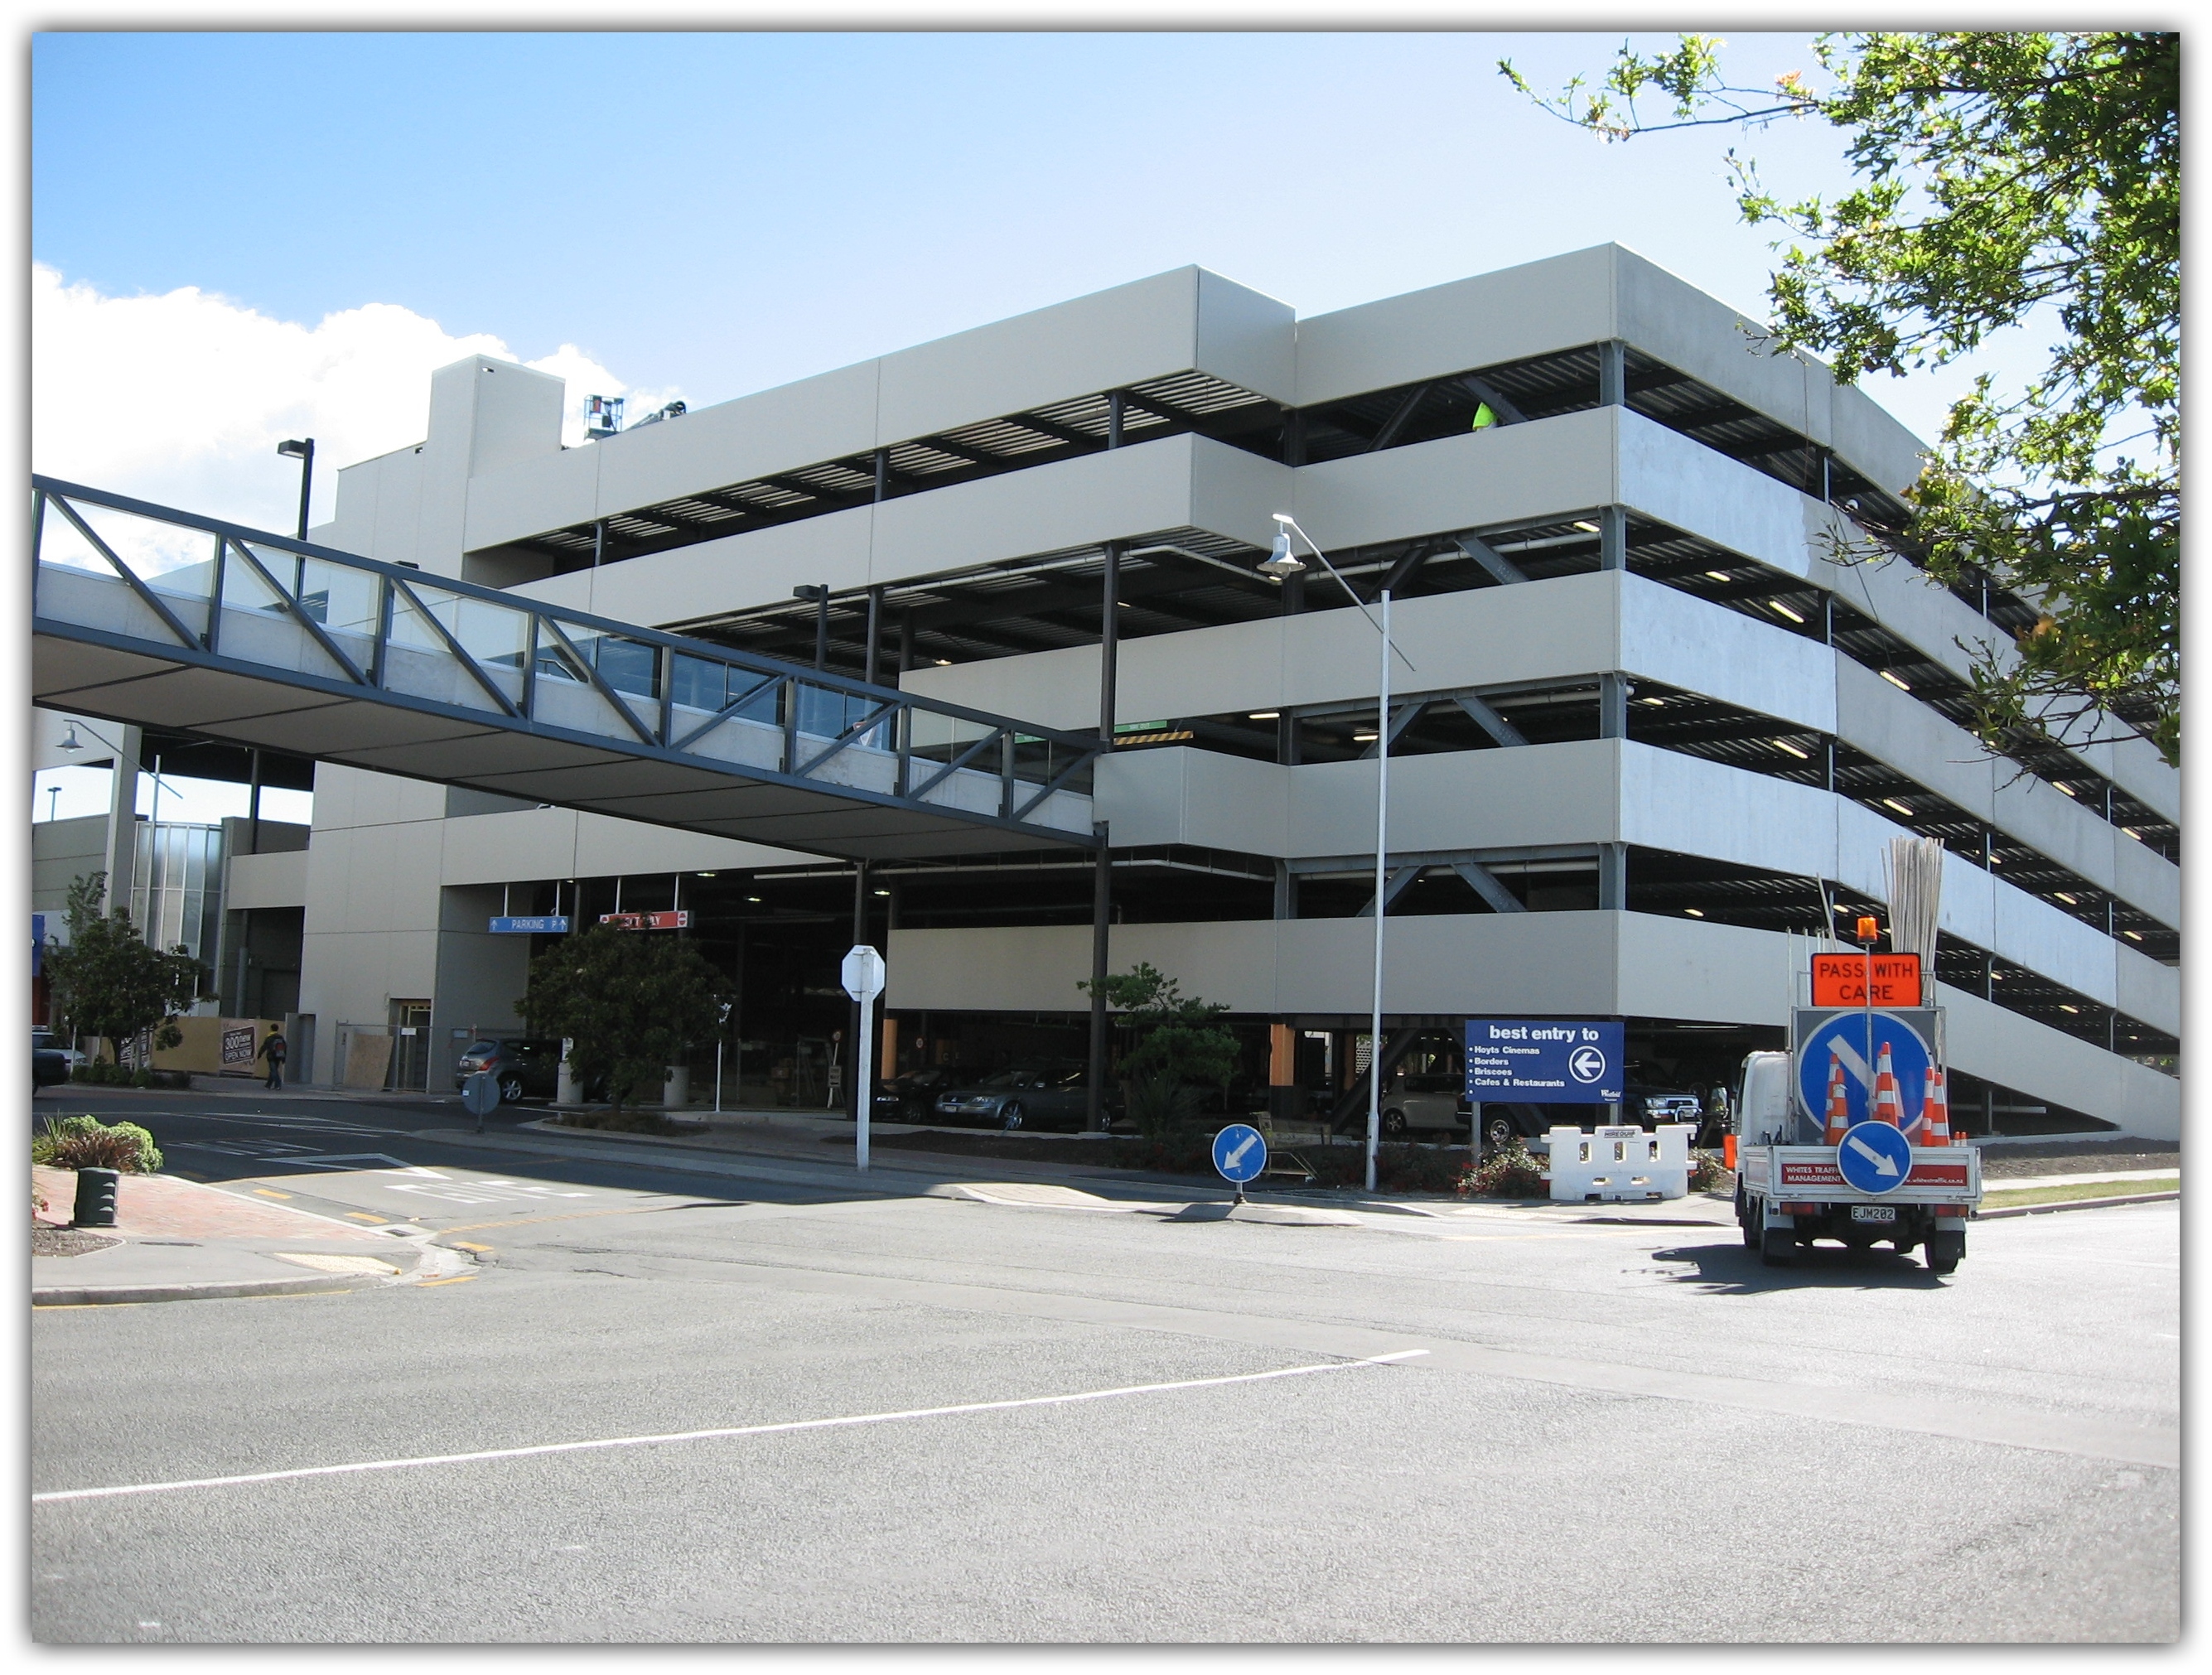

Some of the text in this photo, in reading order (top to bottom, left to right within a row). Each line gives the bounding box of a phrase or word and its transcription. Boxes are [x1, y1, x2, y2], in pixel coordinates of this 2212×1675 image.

[511, 919, 544, 929] PARKING
[1819, 963, 1913, 978] PASS WITH
[1839, 985, 1894, 1001] CARE
[1490, 1025, 1599, 1044] best entry to
[1474, 1045, 1540, 1055] Hoyts Cinemas
[1474, 1058, 1509, 1066] Borders
[1474, 1068, 1513, 1076] Briscoes
[1475, 1078, 1566, 1088] Cafes & Restaurants
[384, 1180, 595, 1204] GIVE
[1852, 1207, 1894, 1220] EJM202
